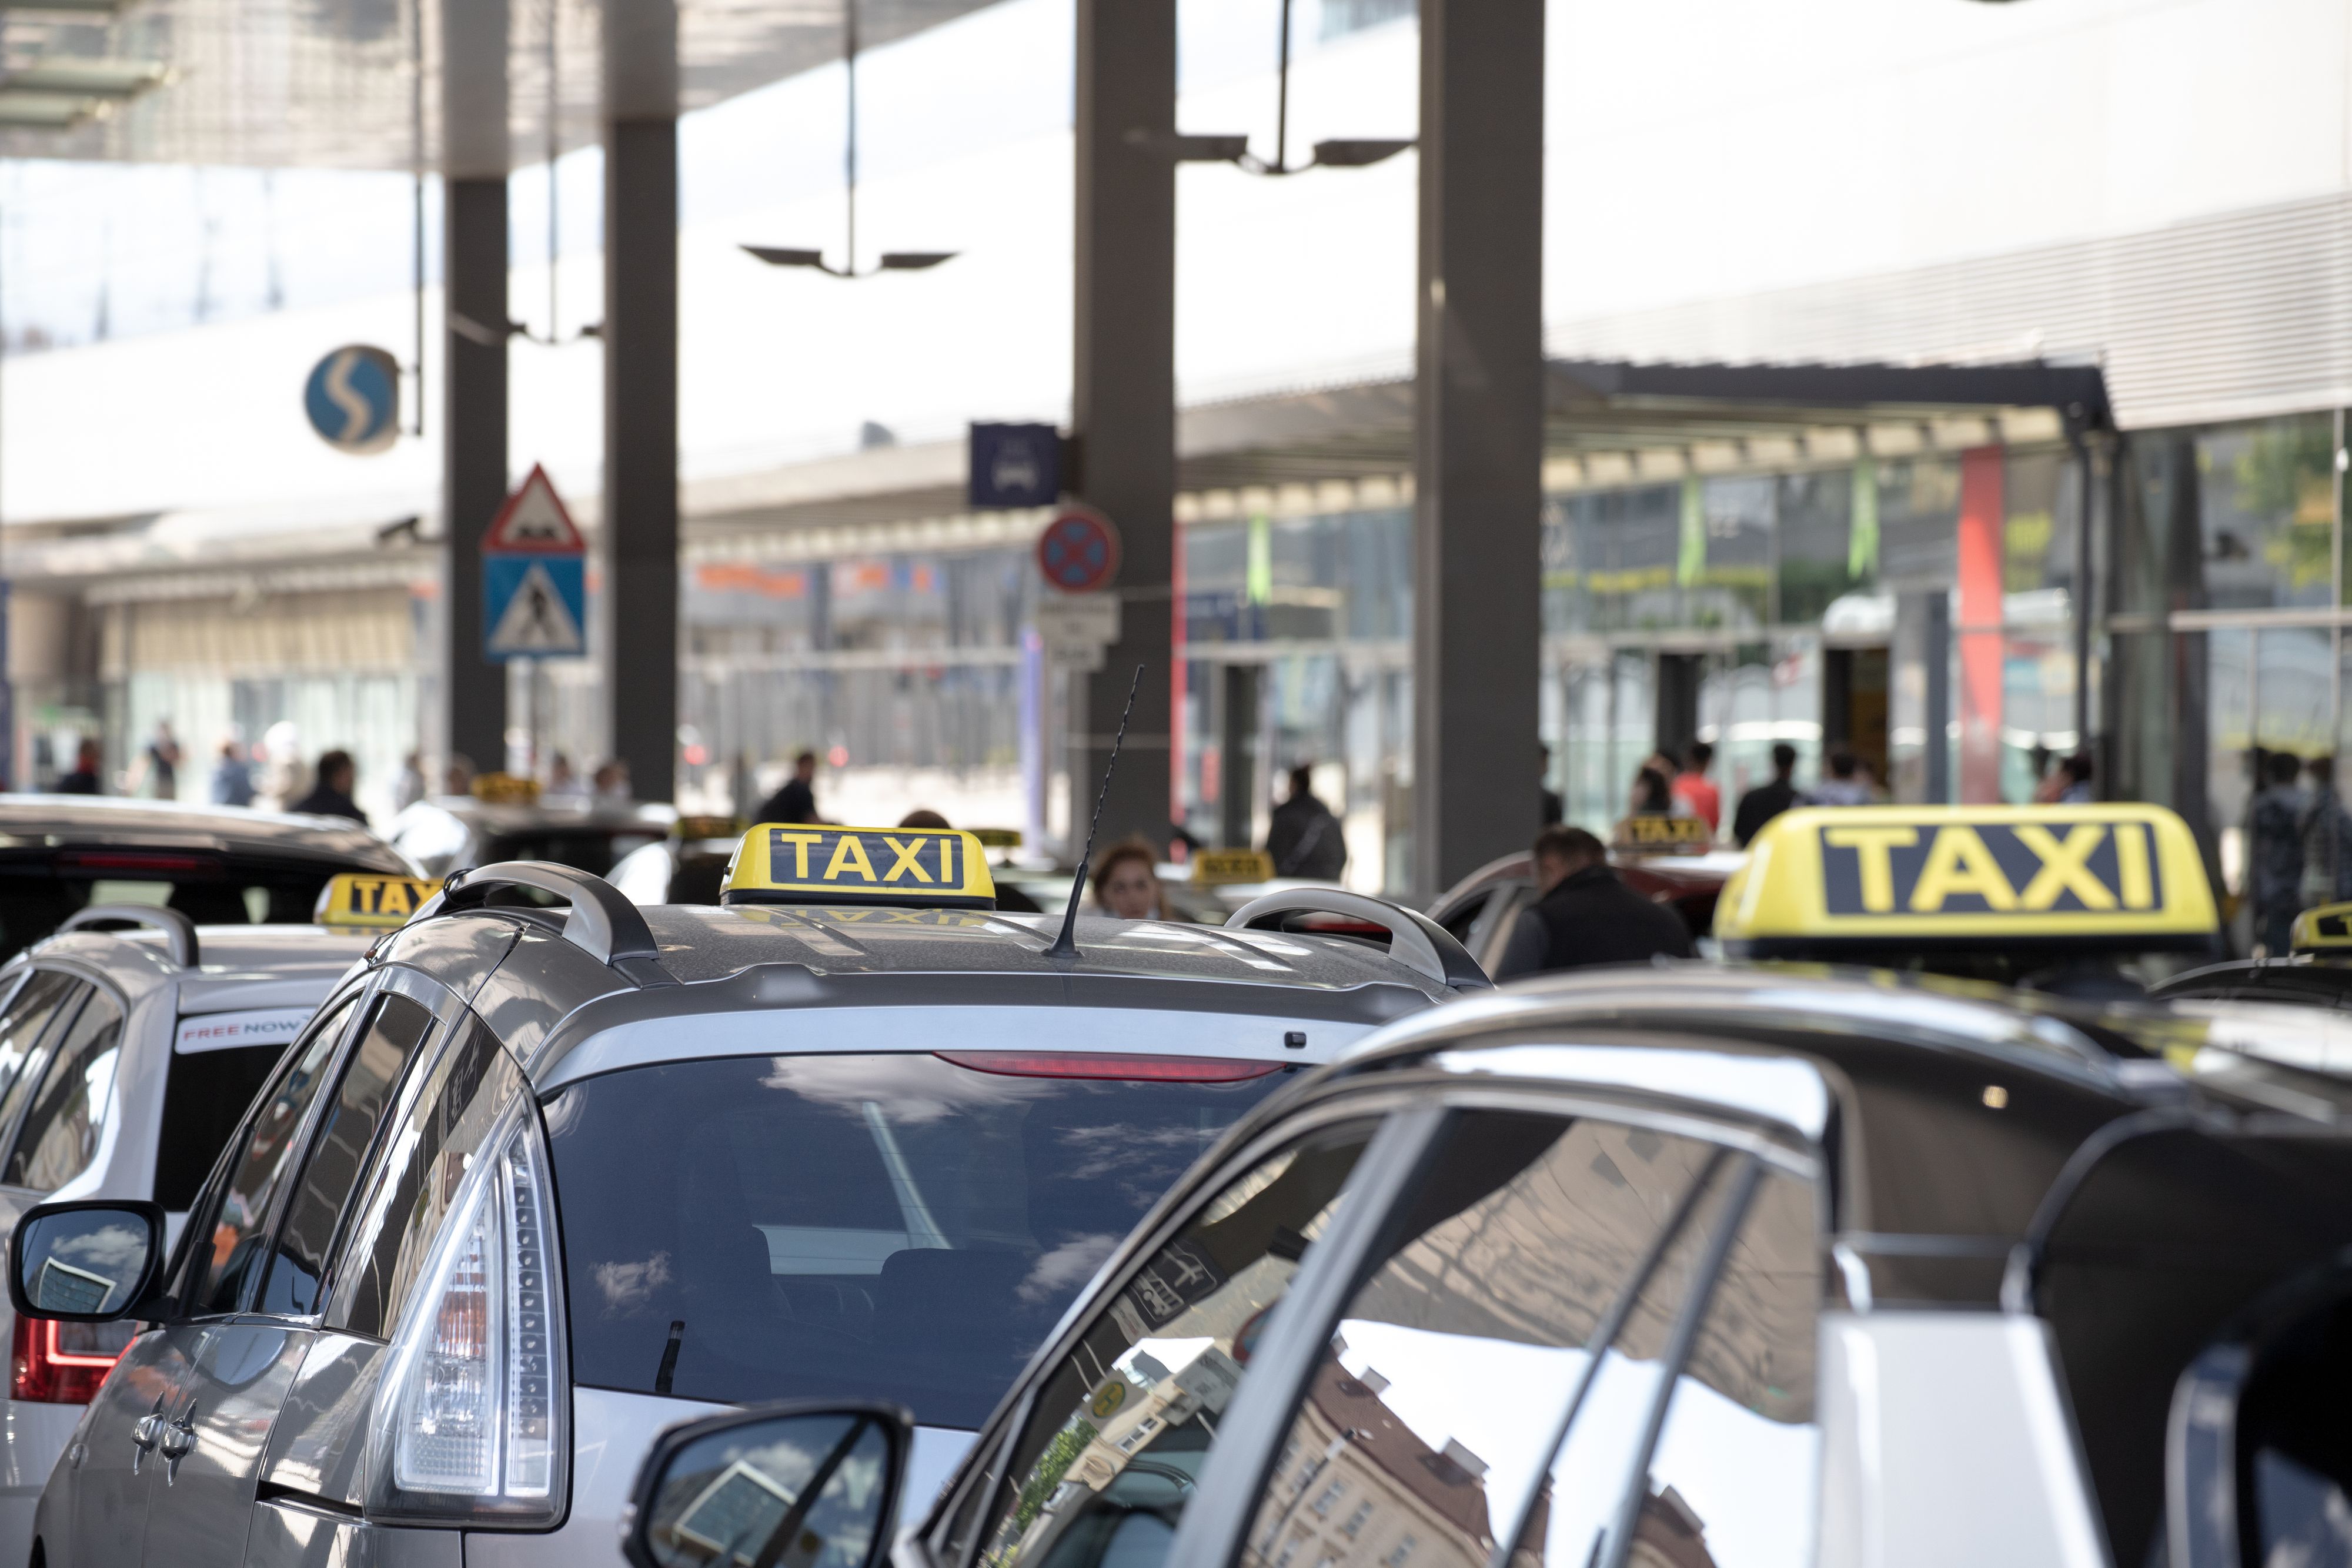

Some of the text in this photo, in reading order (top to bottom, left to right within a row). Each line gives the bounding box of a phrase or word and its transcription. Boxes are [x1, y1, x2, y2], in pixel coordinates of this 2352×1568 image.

[781, 833, 954, 882] TAXI
[1825, 823, 2153, 912] TAXI
[354, 882, 443, 914] TAX
[183, 1019, 299, 1041] FREE NOW
